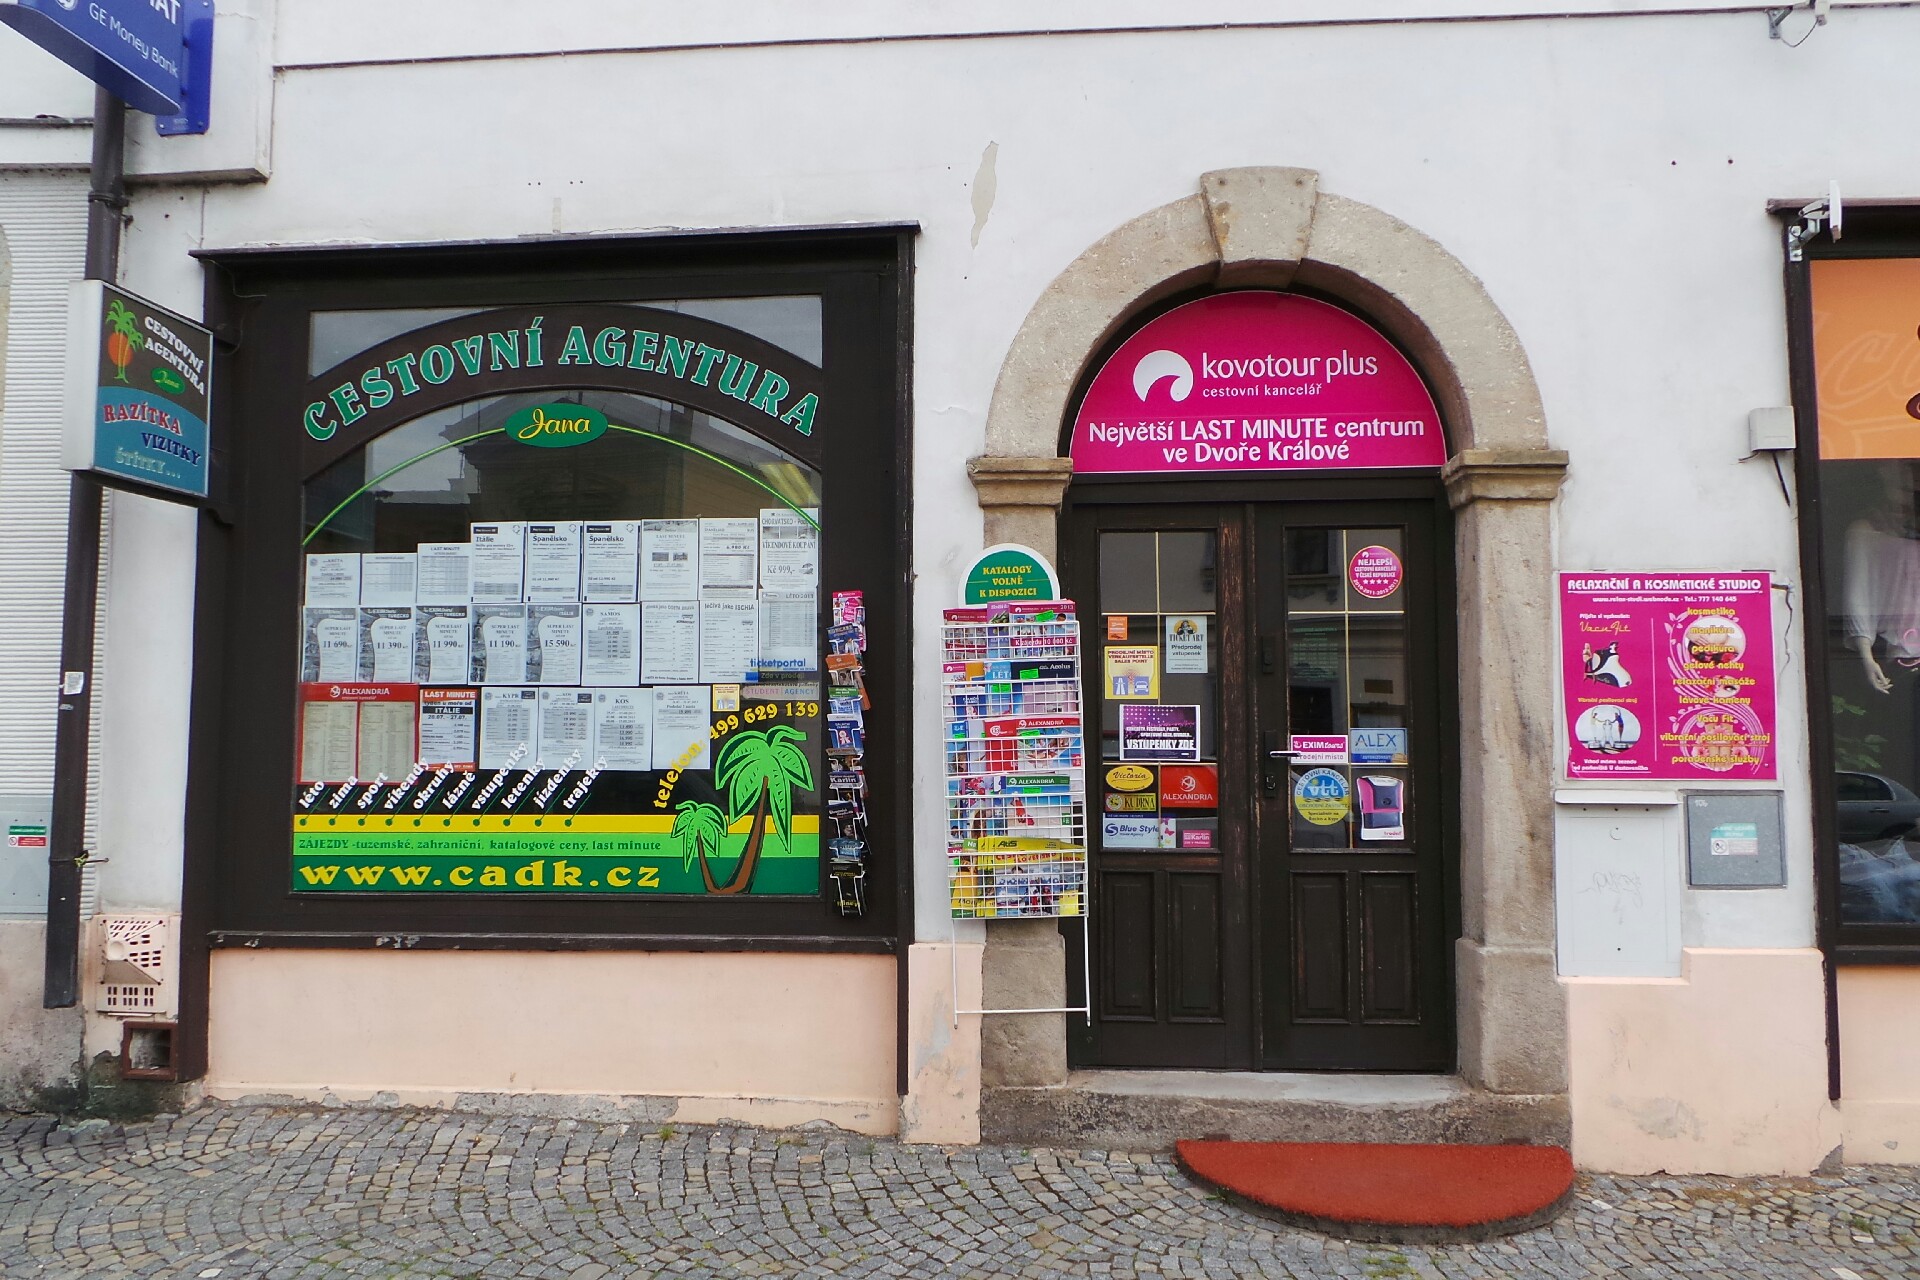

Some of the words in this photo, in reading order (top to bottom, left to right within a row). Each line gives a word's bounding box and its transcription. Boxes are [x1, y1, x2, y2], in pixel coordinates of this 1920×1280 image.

[89, 4, 107, 28] GE
[110, 16, 150, 61] Money
[151, 46, 179, 79] Bank
[144, 316, 205, 374] CESTOVNÍ
[145, 337, 206, 396] AGENTURA
[1202, 352, 1321, 379] kovotour
[1325, 350, 1379, 383] plus
[303, 316, 544, 441] CESTOVNÍ
[558, 325, 820, 437] AGENTURA
[1202, 384, 1259, 398] cestovní
[1264, 382, 1322, 397] kancelář
[103, 401, 183, 437] RAZÍTKA
[518, 408, 591, 440] Jana
[1089, 420, 1173, 448] Největší
[1181, 419, 1236, 441] LAST
[1242, 418, 1328, 440] MINUTE
[1334, 420, 1425, 437] centrum
[141, 432, 202, 466] VIZITKY
[1163, 446, 1188, 463] ve
[1195, 442, 1261, 462] Dvoře
[1268, 440, 1350, 461] Králové
[1358, 558, 1393, 566] NEJLEPŠÍ
[767, 565, 776, 574] Kč
[778, 565, 795, 575] 999,-
[983, 566, 1032, 575] KATALOGY
[992, 575, 1023, 586] VOLNĚ
[1567, 577, 1630, 590] RELAXAČNÍ
[1633, 580, 1641, 590] A
[1644, 577, 1715, 590] KOSMETICKÉ
[1718, 579, 1761, 590] STUDIO
[989, 588, 1037, 597] DISPOZICI
[1687, 607, 1735, 618] kosmetika
[323, 640, 331, 648] 11
[333, 640, 348, 648] 690
[432, 640, 441, 648] 11
[444, 640, 458, 648] 990
[489, 640, 498, 648] 11
[501, 640, 515, 648] 190
[544, 640, 554, 648] 15
[555, 640, 570, 648] 590
[1171, 644, 1202, 652] Předprodej
[750, 658, 806, 669] ticketportal
[1683, 661, 1715, 670] gelové
[1718, 661, 1744, 671] nehty
[1672, 677, 1715, 685] relaxační
[1719, 677, 1755, 685] masáže
[342, 687, 390, 695] ALEXANDRIA
[745, 688, 779, 696] STUDENT
[784, 687, 815, 696] AGENCY
[1679, 695, 1710, 704] lávové
[1713, 696, 1751, 705] kameny
[709, 714, 739, 740] 499
[743, 703, 778, 724] 629
[785, 702, 819, 718] 139
[1126, 739, 1177, 749] VSTUPENKY
[1178, 739, 1194, 749] ZDE
[1355, 733, 1397, 747] ALEX
[1660, 732, 1697, 742] vibrační
[1699, 732, 1748, 742] posilovací
[1750, 733, 1770, 743] stroj
[1672, 755, 1727, 764] poradenské
[1730, 755, 1760, 764] služby
[471, 742, 528, 810] vstupenky
[500, 756, 546, 809] letenky
[532, 748, 582, 810] jízdenky
[1113, 771, 1147, 779] Victoria
[357, 772, 388, 809] sport
[384, 757, 430, 810] víkendy
[413, 760, 454, 809] okruhy
[442, 770, 476, 810] lázně
[1308, 780, 1339, 796] vtt
[299, 780, 325, 809] léto
[329, 775, 358, 809] zima
[1139, 825, 1159, 833] Style
[299, 836, 349, 849] ZÁJEZDY
[489, 839, 555, 852] katalogové
[591, 840, 614, 850] last
[617, 841, 661, 850] minute
[299, 860, 660, 888] www.cadk.cz
